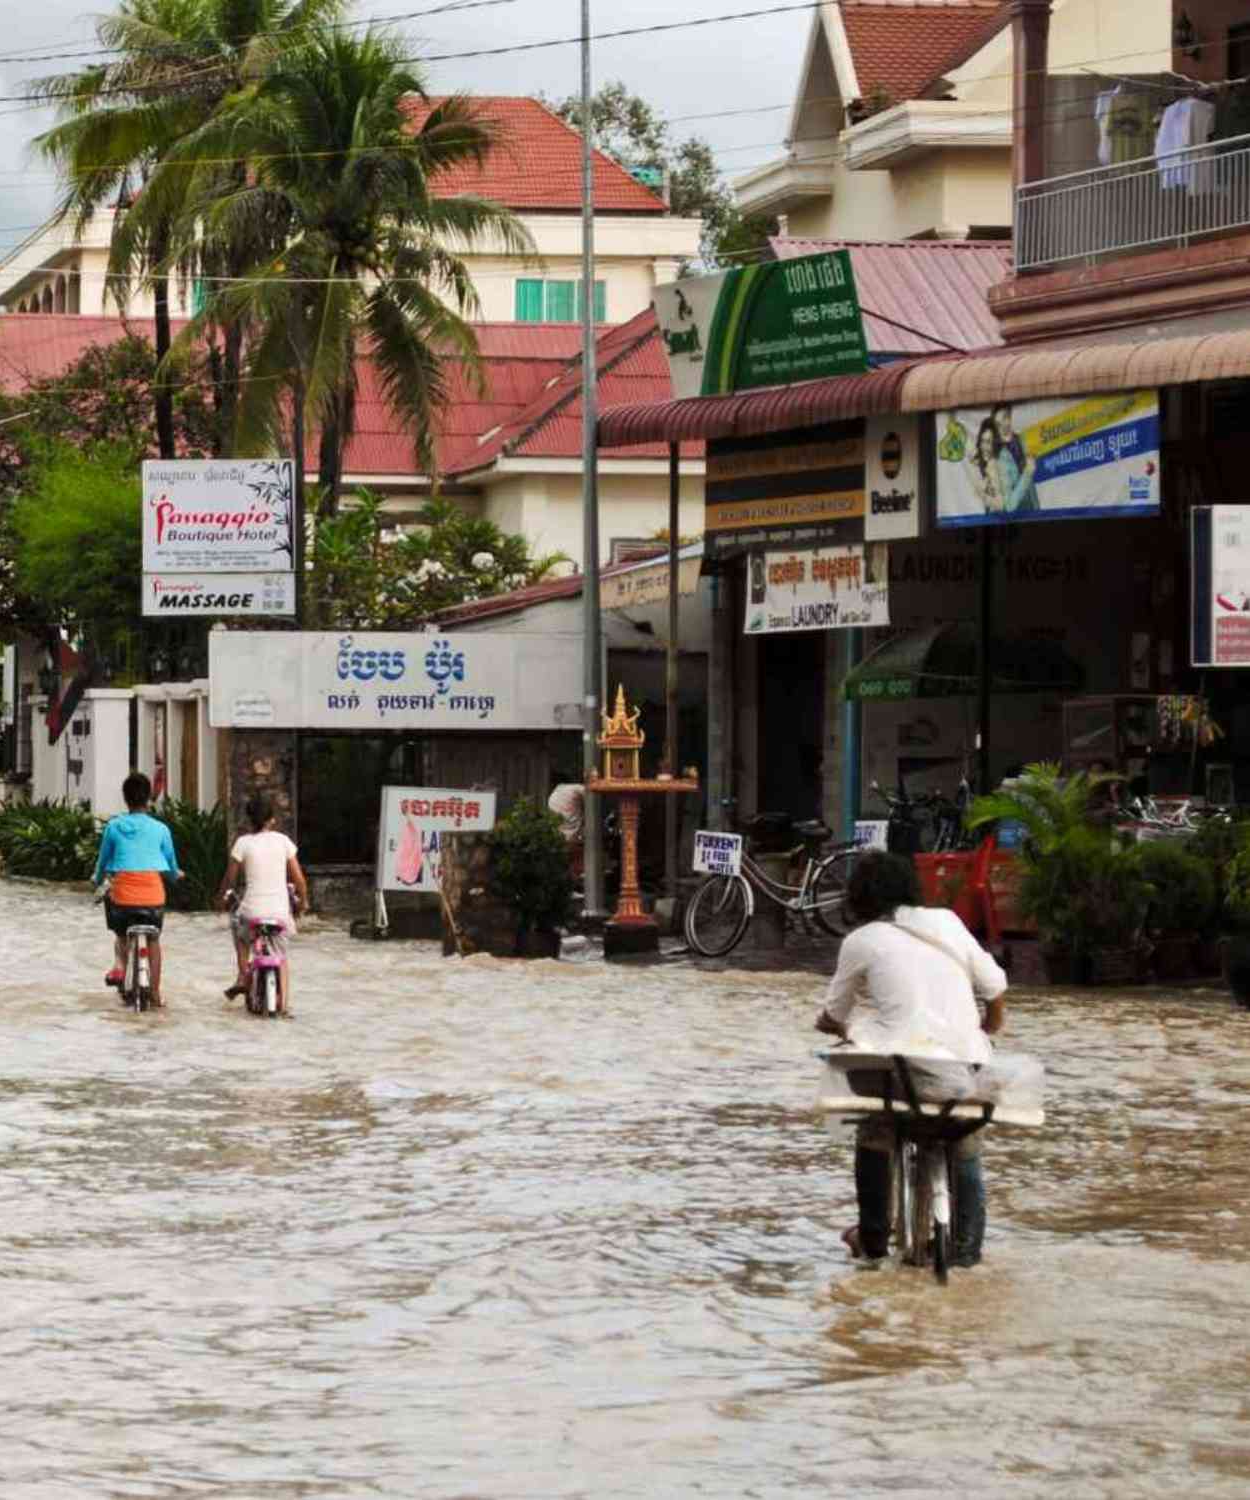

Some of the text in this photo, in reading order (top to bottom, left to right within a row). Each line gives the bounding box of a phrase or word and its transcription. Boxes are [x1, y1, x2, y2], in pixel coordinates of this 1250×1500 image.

[166, 529, 278, 543] Boutique Hotel
[159, 593, 254, 608] MASSAGE
[792, 603, 838, 628] LAUNDRY
